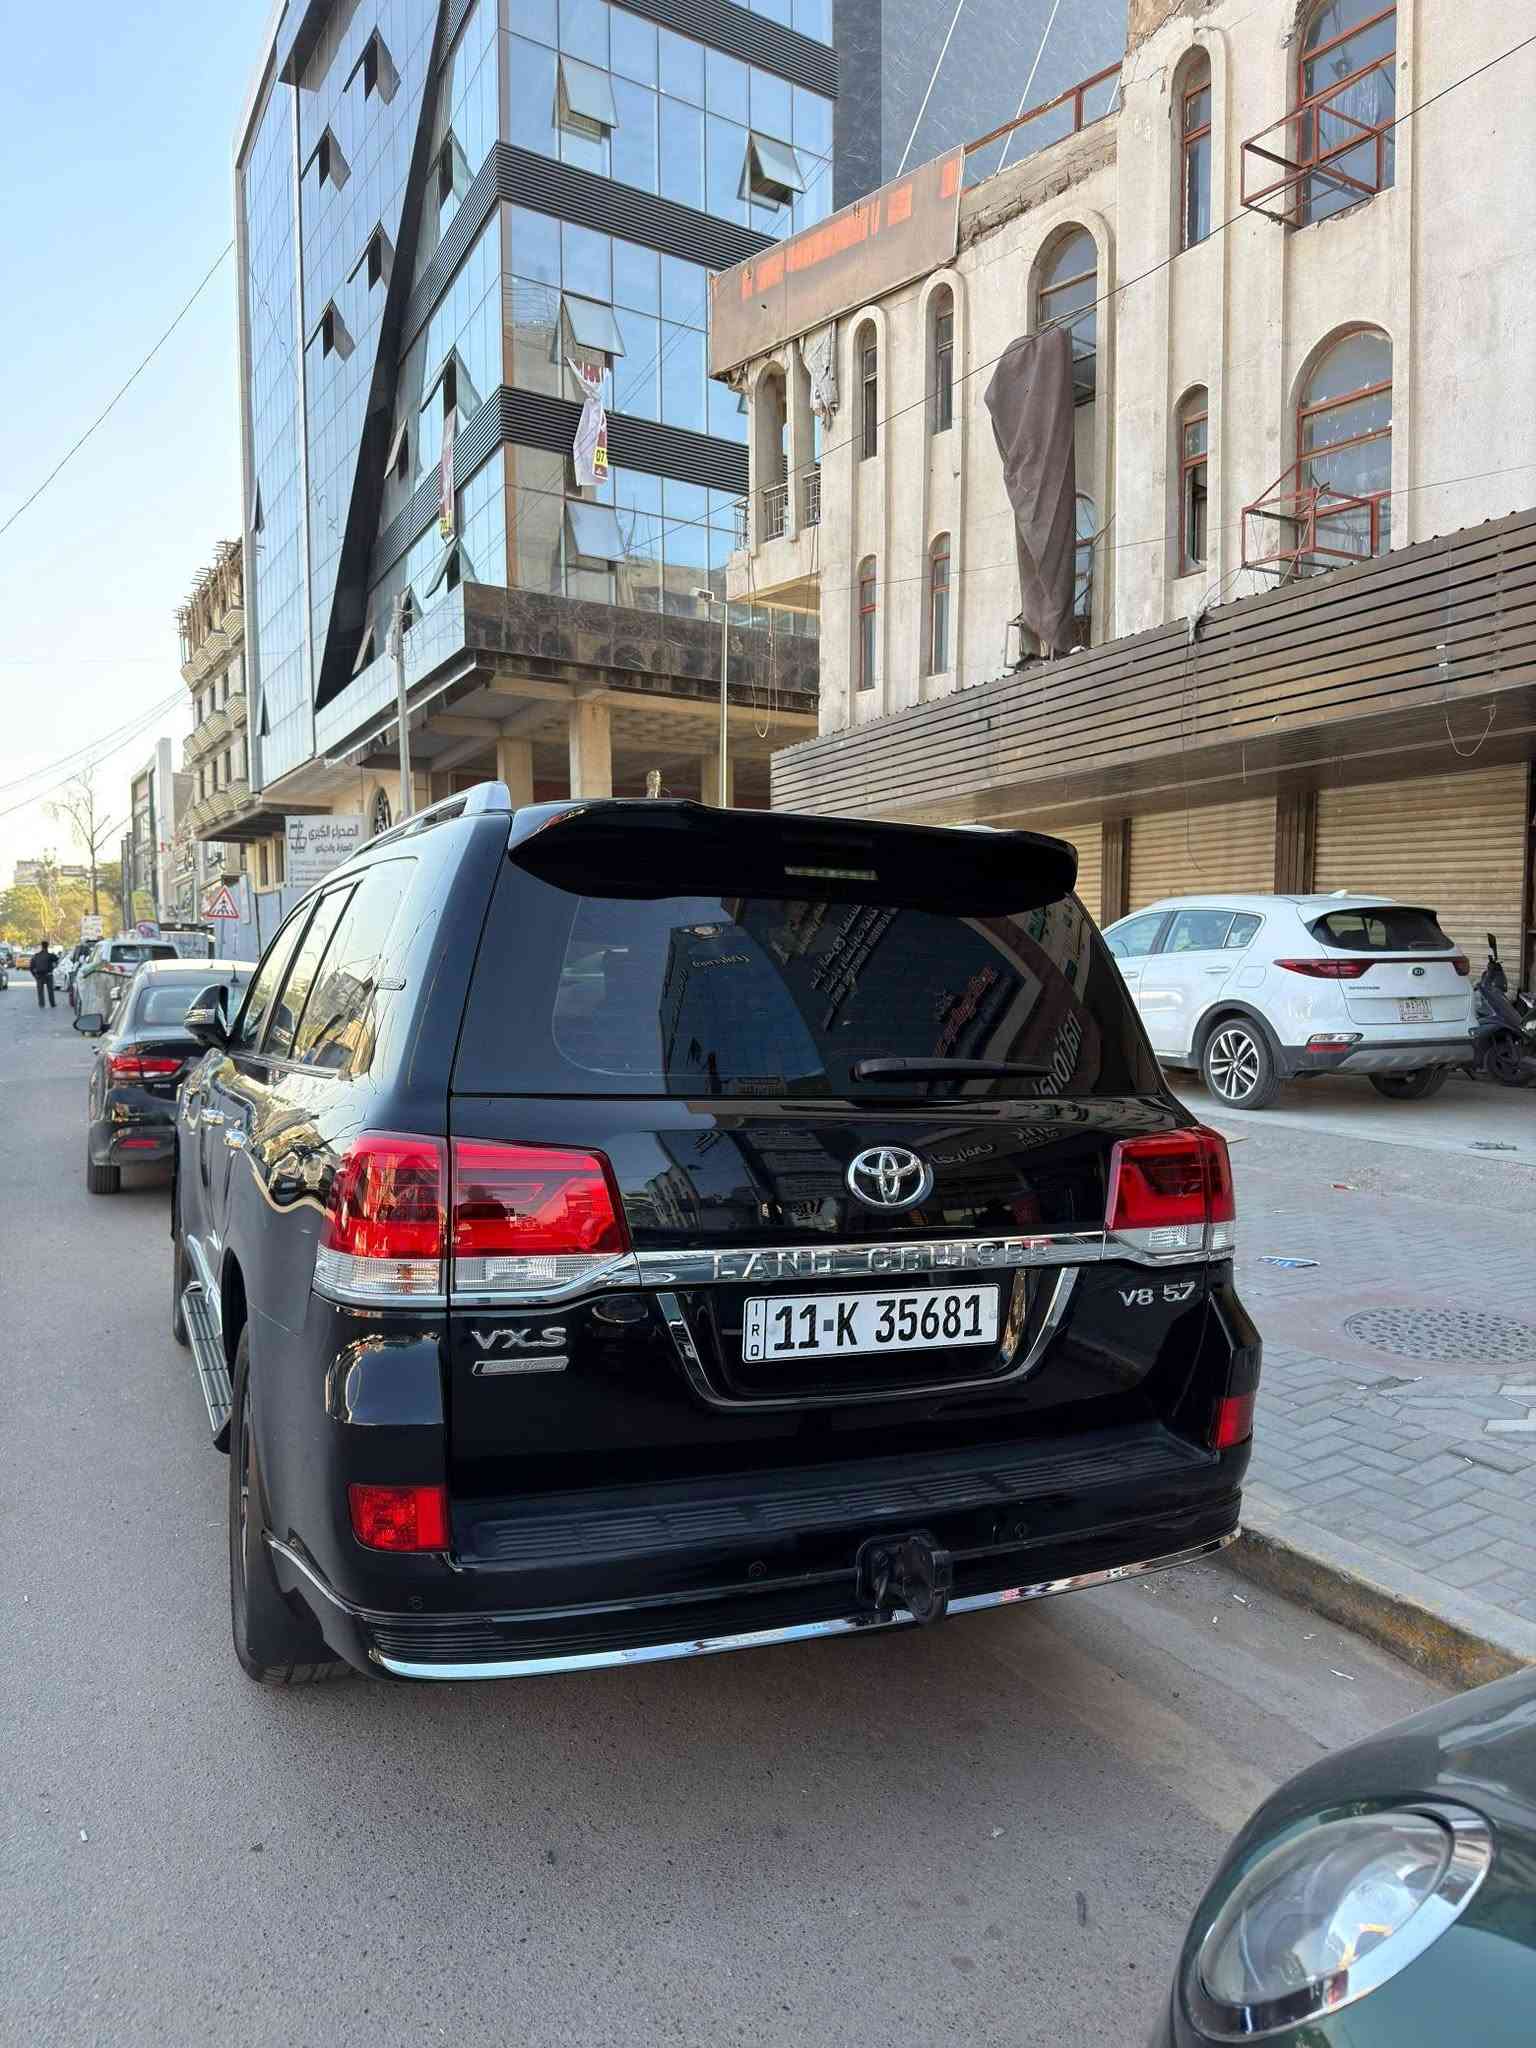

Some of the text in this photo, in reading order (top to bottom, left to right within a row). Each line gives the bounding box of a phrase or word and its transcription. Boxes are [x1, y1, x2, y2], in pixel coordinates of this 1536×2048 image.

[713, 1238, 1052, 1280] LAND CRUISER
[1119, 1288, 1154, 1306] V8
[875, 1294, 983, 1343] 35681
